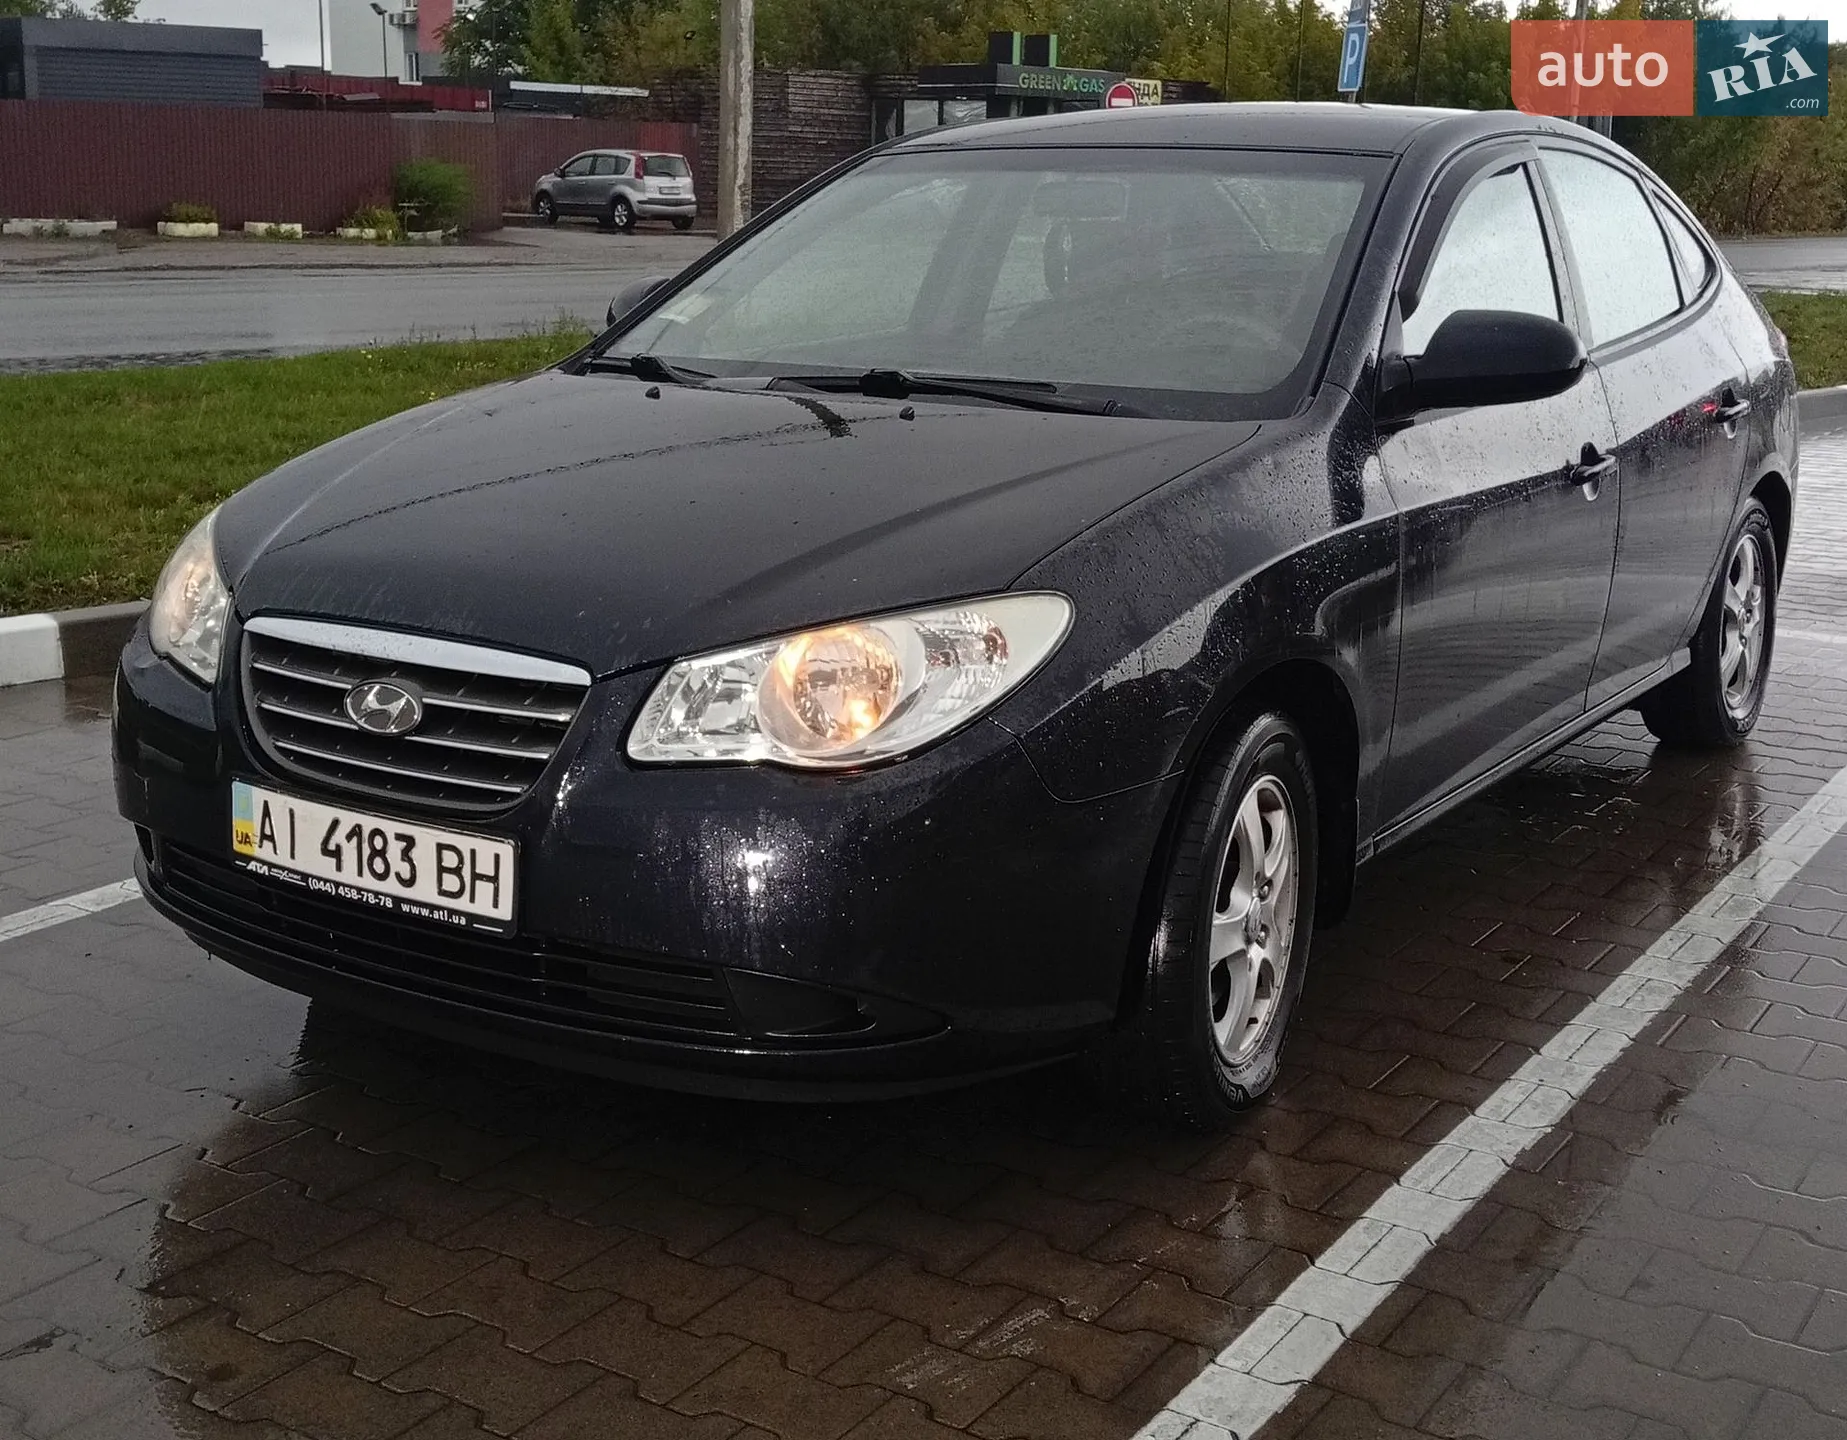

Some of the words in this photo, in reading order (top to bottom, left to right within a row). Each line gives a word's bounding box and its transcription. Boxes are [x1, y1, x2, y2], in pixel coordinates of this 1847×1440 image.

[1019, 72, 1061, 91] GREEN
[1079, 77, 1106, 93] GAS
[1343, 32, 1360, 84] P
[235, 829, 253, 848] UA
[320, 816, 418, 889] 4183
[435, 842, 501, 910] BH
[308, 876, 336, 896] (044)
[337, 885, 393, 909] 458-78-78
[400, 902, 467, 926] www.atl.ua
